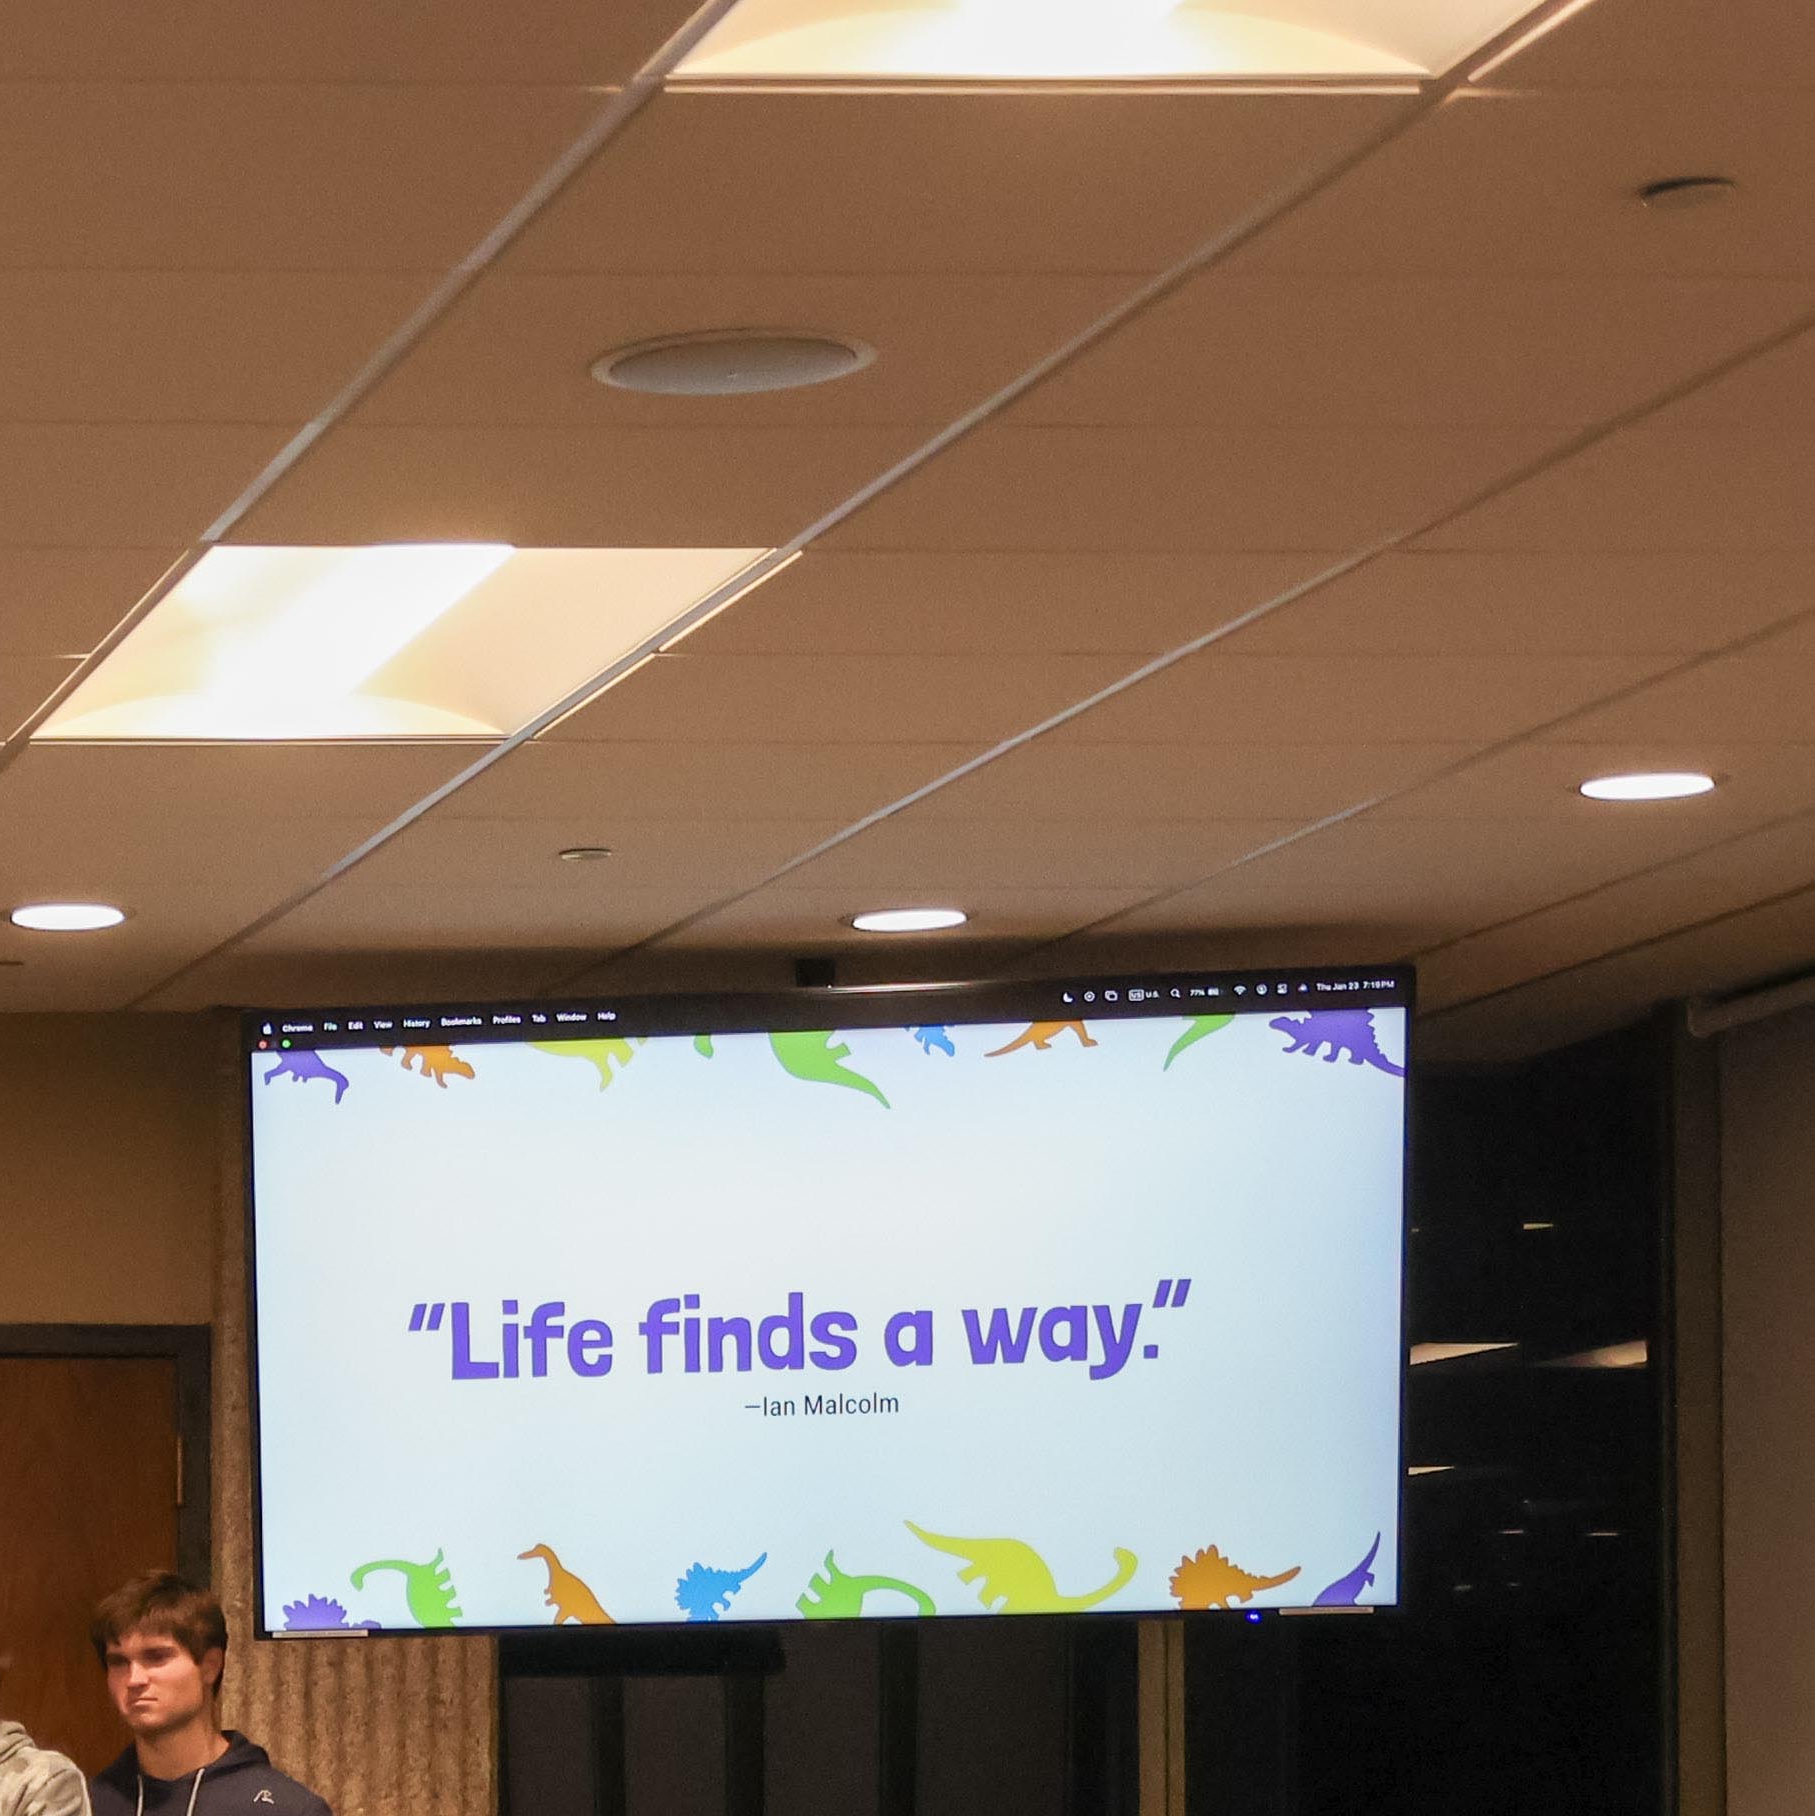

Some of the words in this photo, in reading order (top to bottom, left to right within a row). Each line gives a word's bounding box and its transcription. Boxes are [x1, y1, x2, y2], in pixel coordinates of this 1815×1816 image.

[638, 1291, 858, 1374] finds
[884, 1310, 934, 1367] a
[804, 1392, 900, 1416] Malcolm
